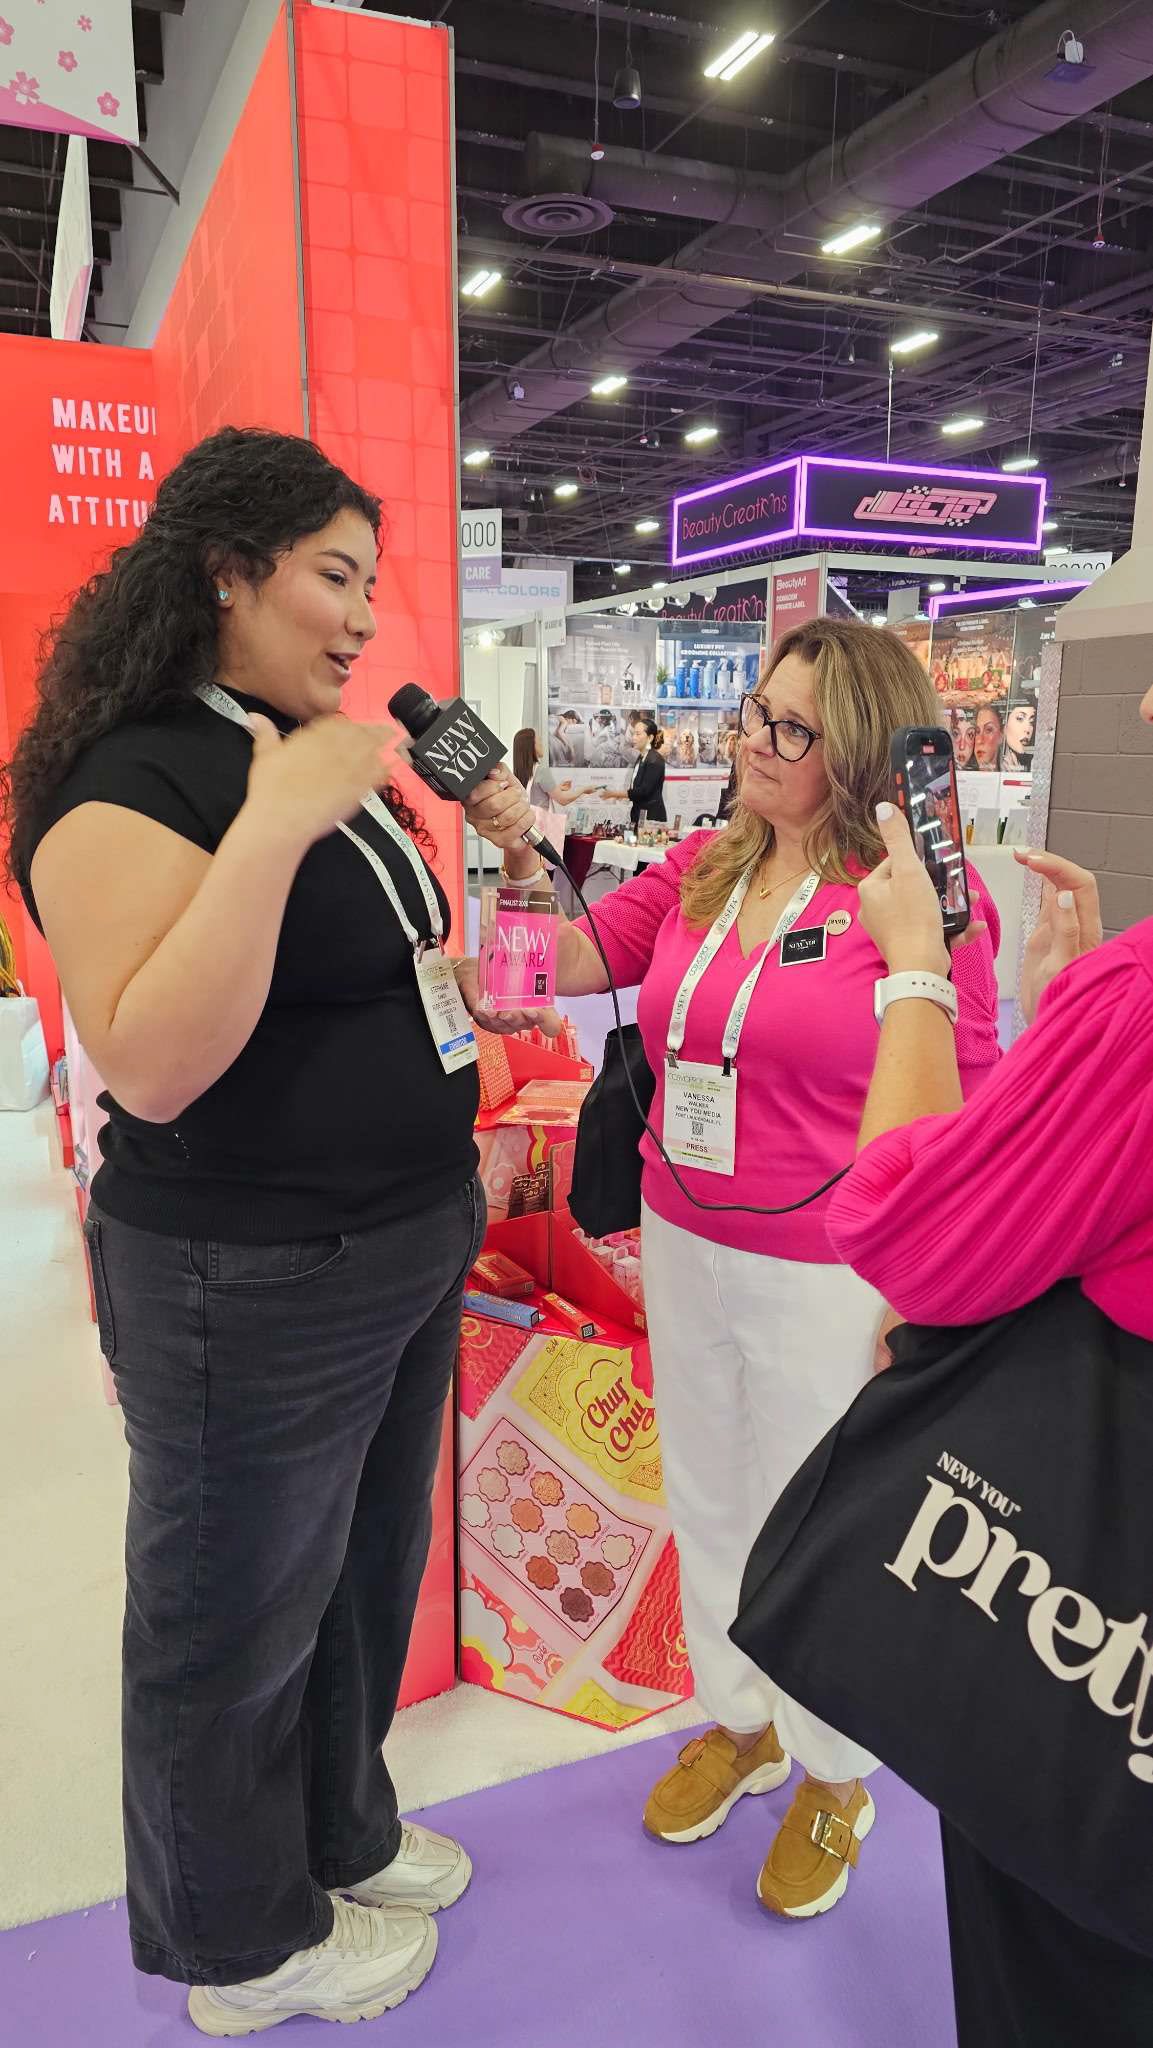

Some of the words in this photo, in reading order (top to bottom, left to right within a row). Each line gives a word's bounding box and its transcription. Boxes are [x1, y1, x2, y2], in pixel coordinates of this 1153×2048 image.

[51, 444, 122, 478] WITH
[138, 451, 155, 480] A
[48, 494, 152, 528] ATTITU
[465, 566, 492, 580] CARE
[497, 584, 561, 598] COLORS
[425, 710, 476, 770] NEW
[442, 732, 490, 783] YOU
[500, 952, 545, 968] AWARD
[683, 1091, 715, 1103] VANESSA
[675, 1104, 689, 1113] NEW
[703, 1110, 721, 1118] MEDIA
[686, 1142, 708, 1153] PRESS
[936, 1451, 981, 1490] NEW
